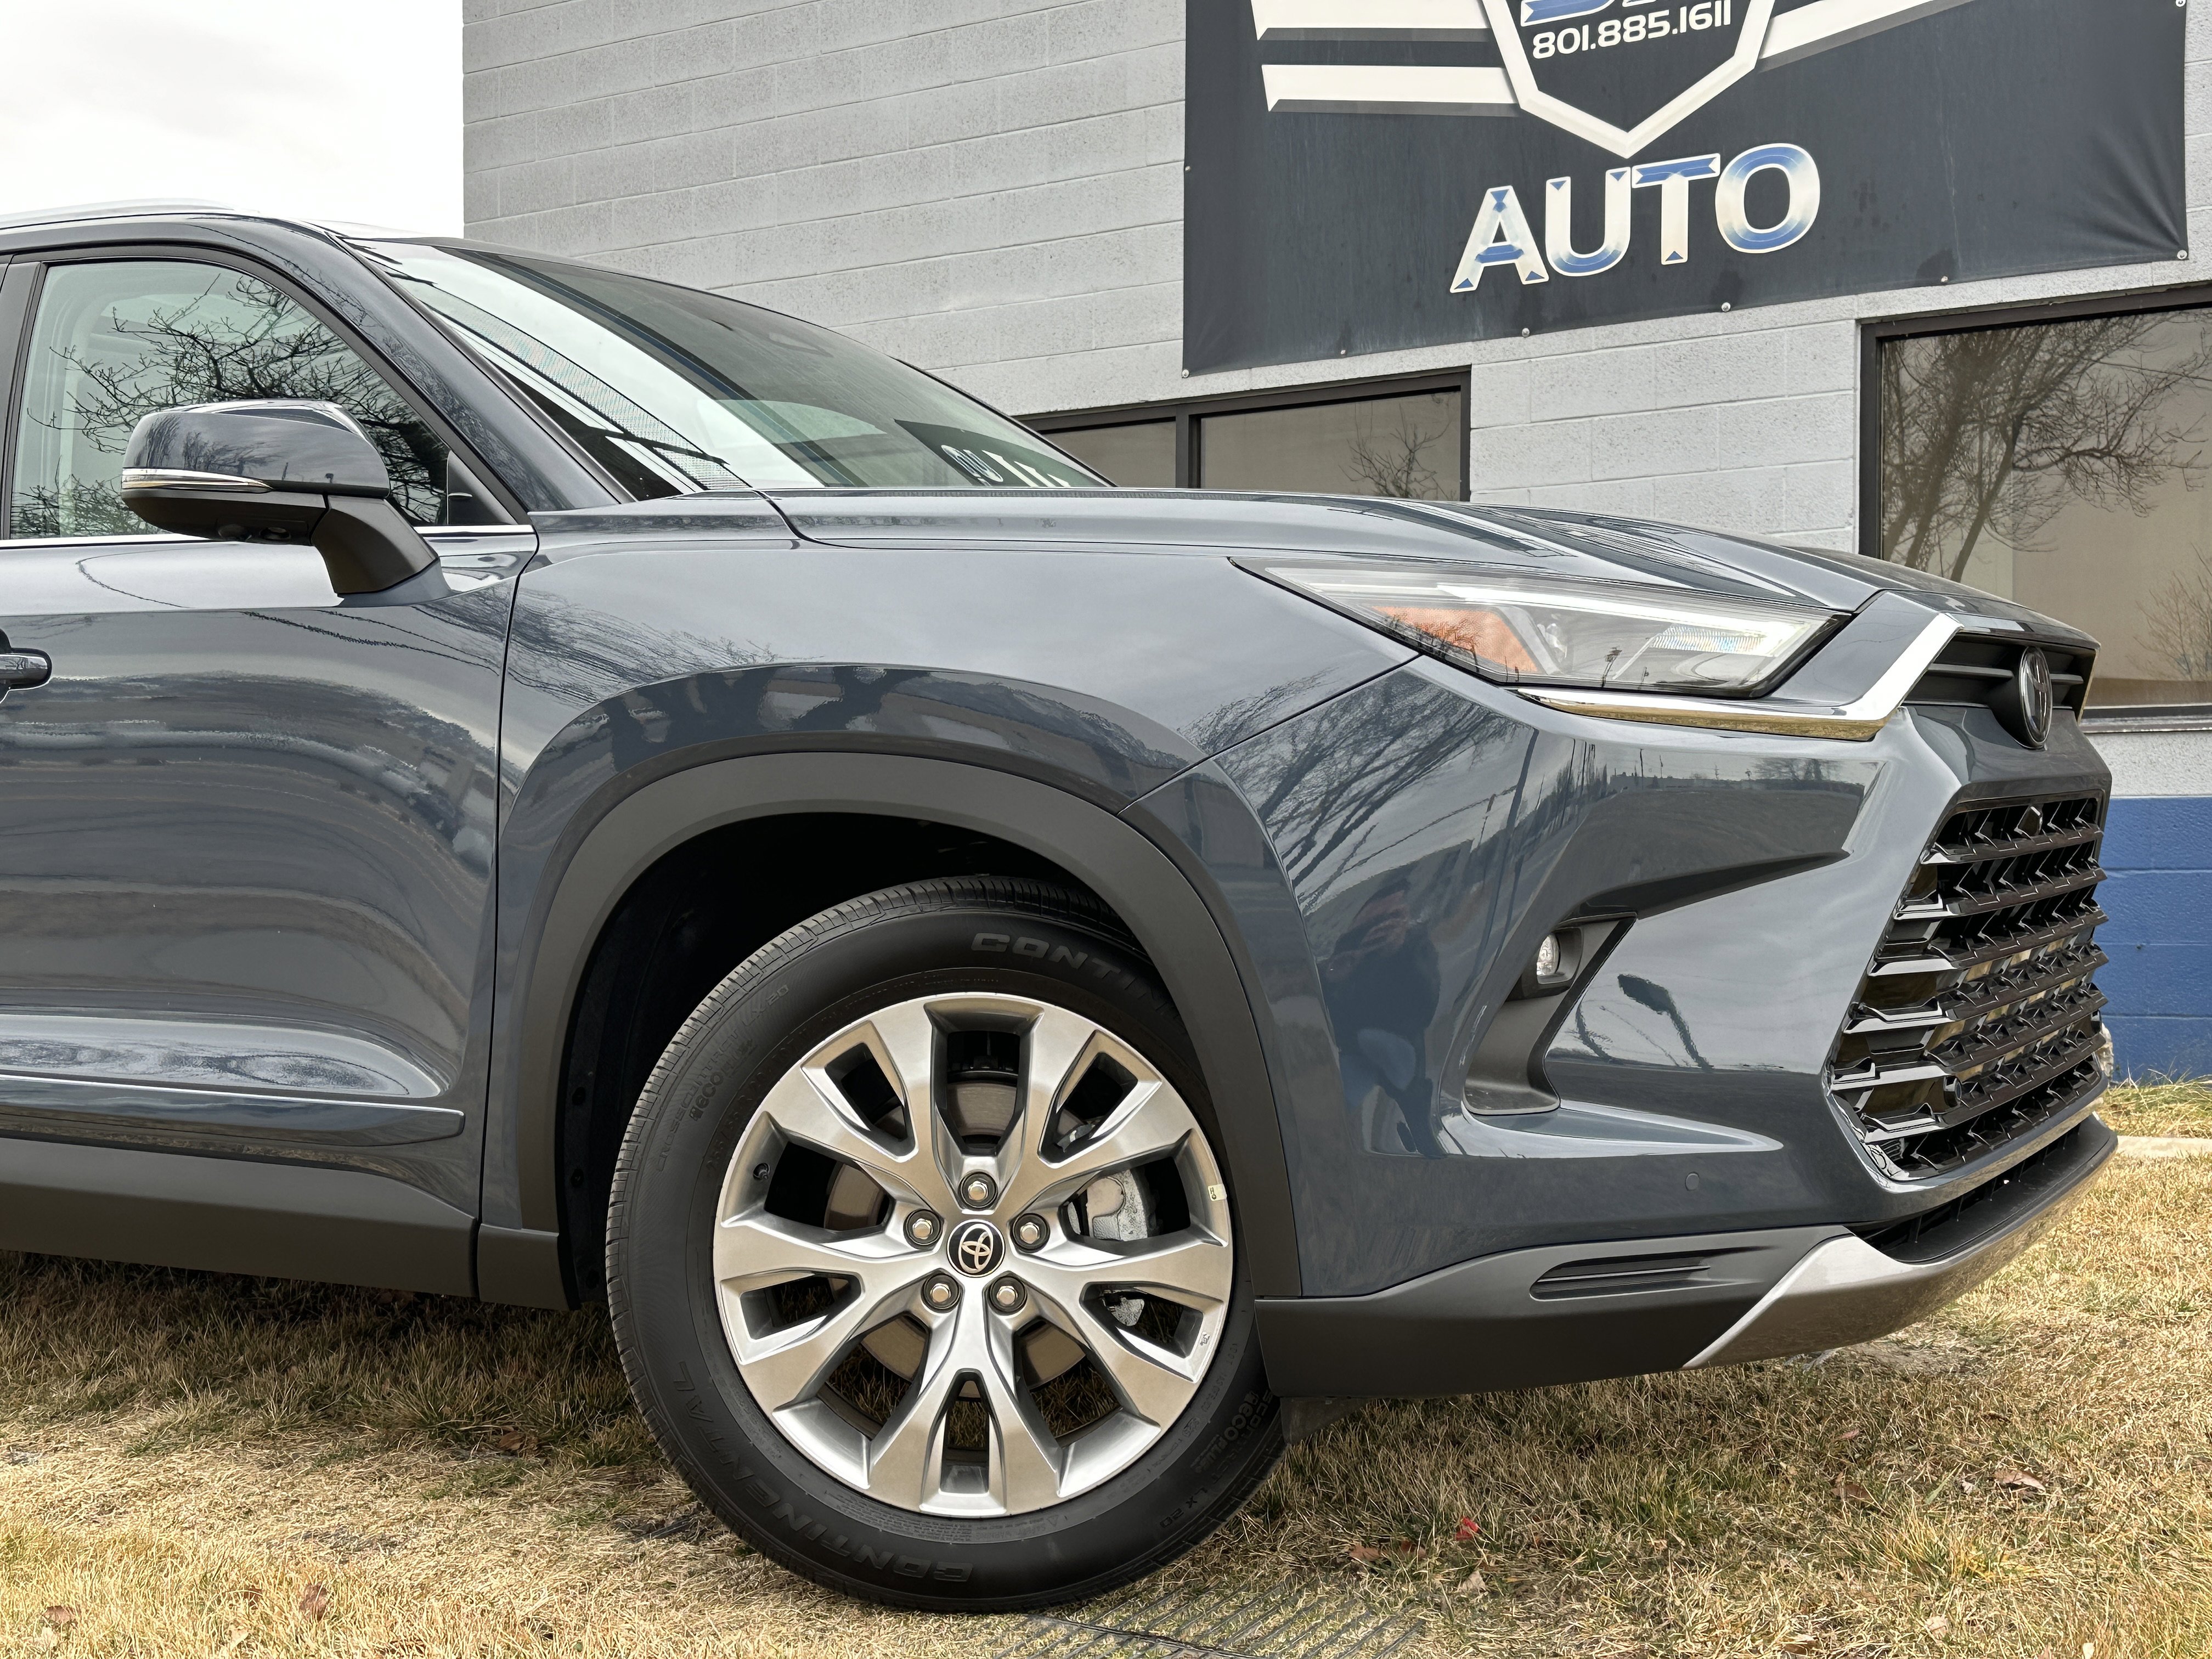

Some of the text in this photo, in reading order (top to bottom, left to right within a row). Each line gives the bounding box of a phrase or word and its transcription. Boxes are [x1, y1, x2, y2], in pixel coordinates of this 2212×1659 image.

[1532, 0, 1731, 59] 801.885.1611
[1450, 143, 1820, 294] AUTO
[767, 984, 790, 1006] 20
[673, 1361, 974, 1582] CONTINENTAL
[1159, 1507, 1184, 1528] 20
[1186, 1486, 1209, 1509] LX
